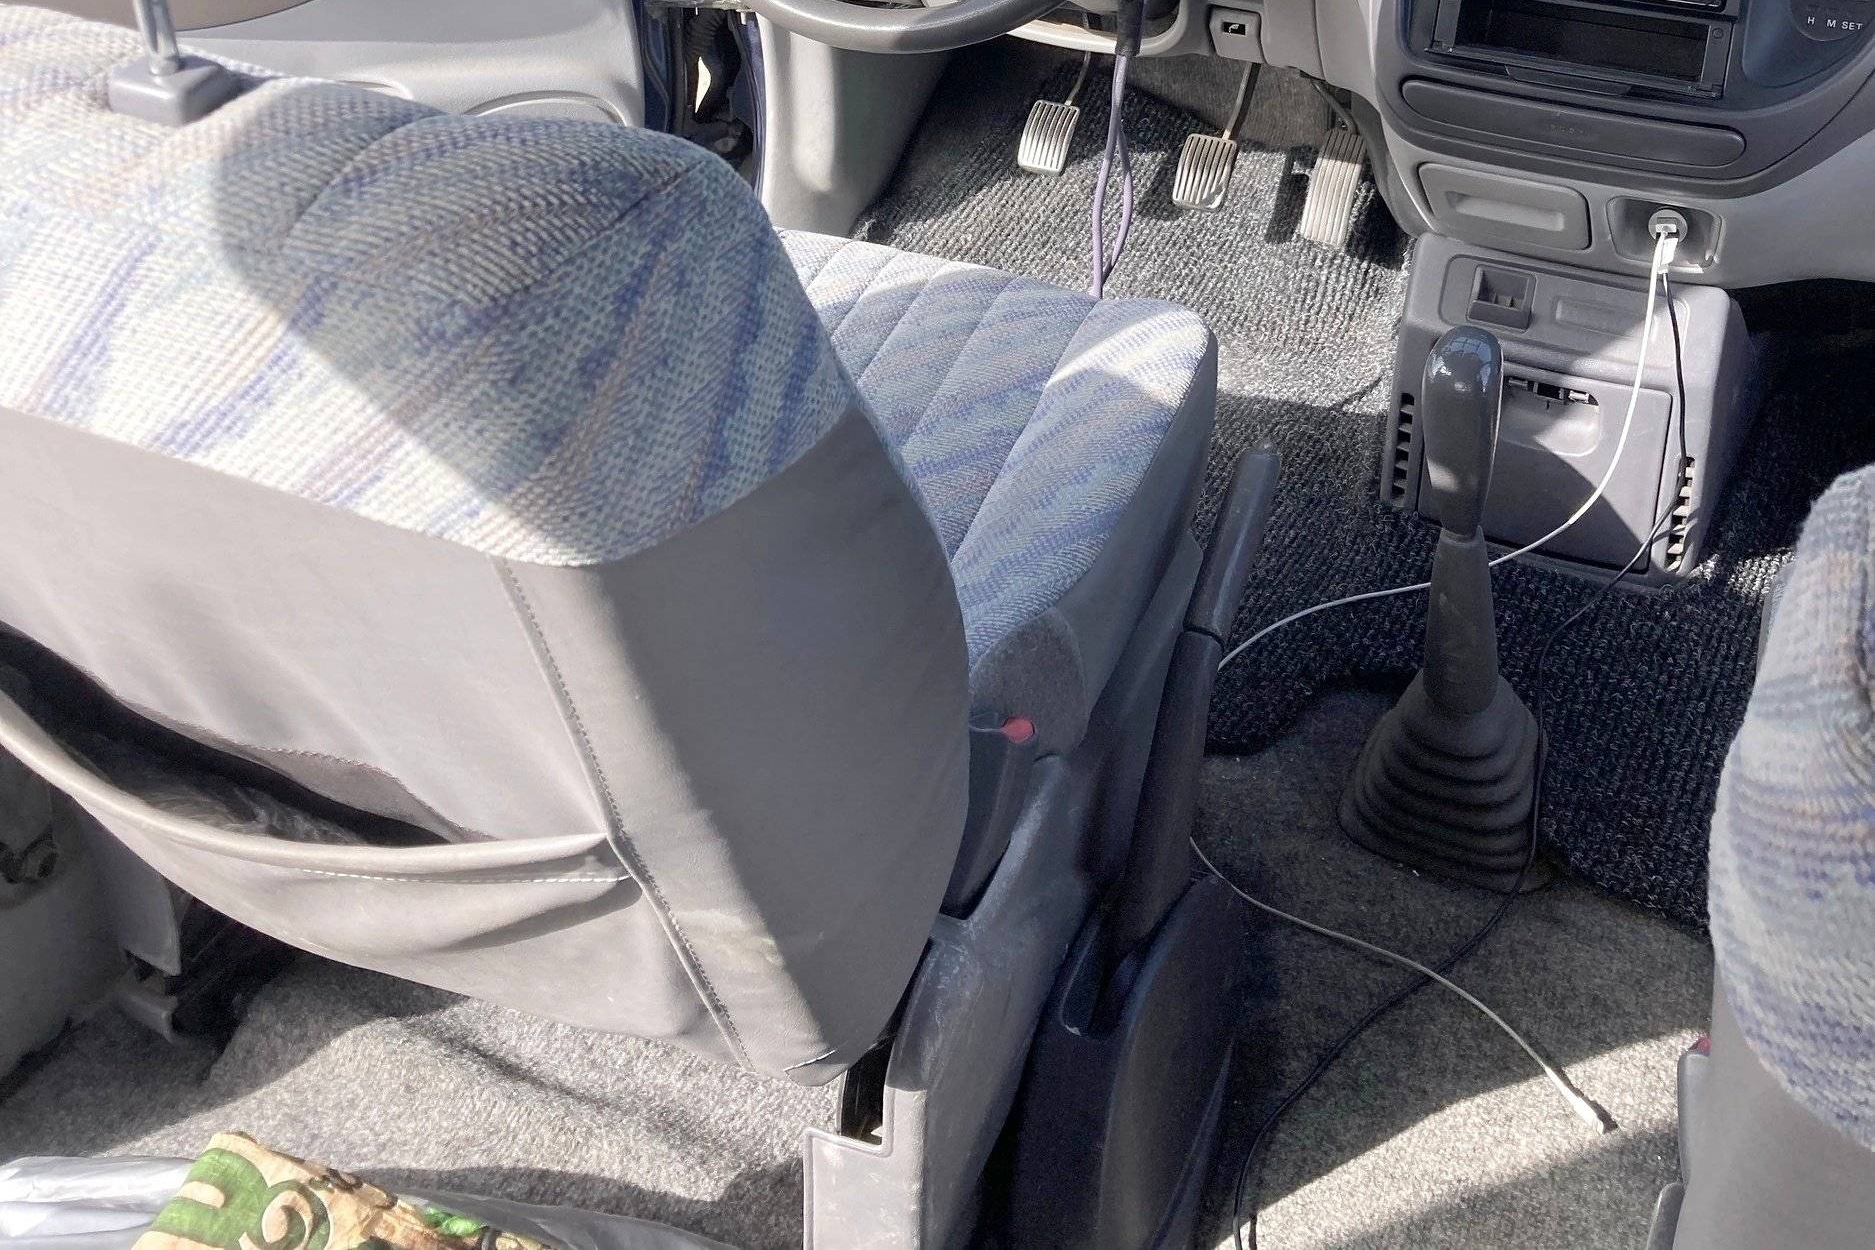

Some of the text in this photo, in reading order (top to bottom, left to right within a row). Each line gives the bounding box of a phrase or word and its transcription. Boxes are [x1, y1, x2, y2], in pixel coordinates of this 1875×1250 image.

[1807, 16, 1863, 31] H M SET
